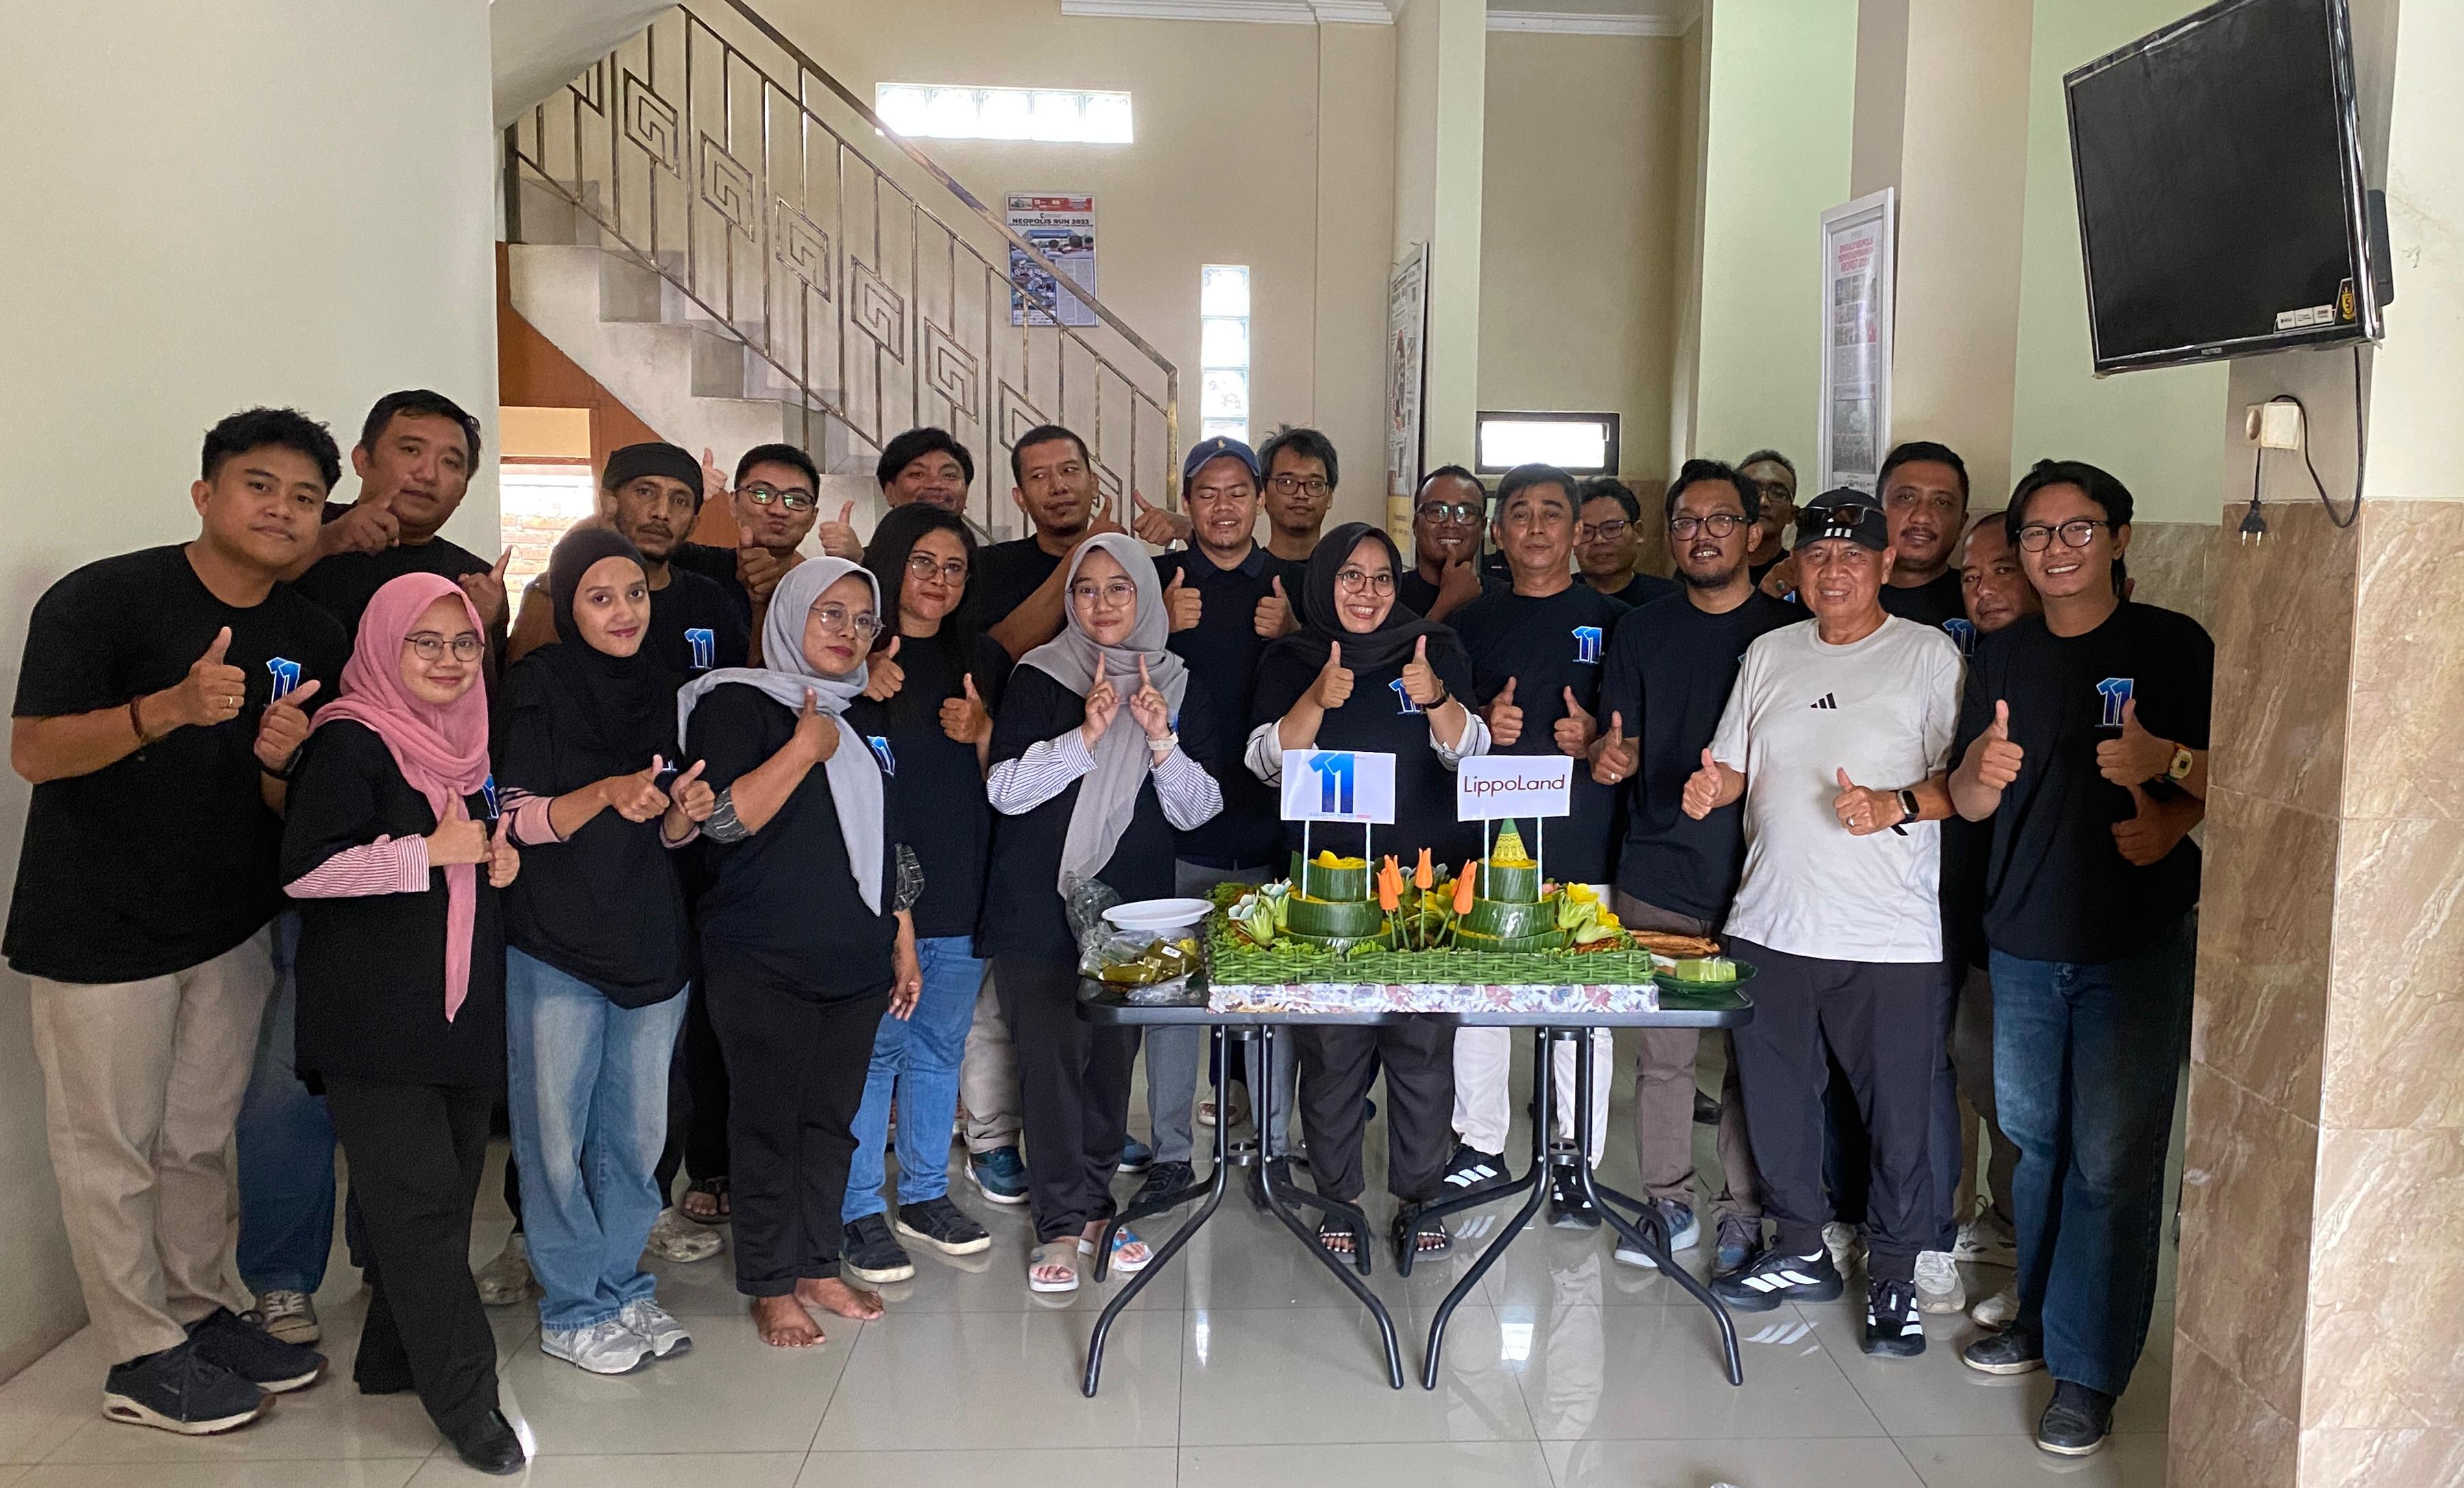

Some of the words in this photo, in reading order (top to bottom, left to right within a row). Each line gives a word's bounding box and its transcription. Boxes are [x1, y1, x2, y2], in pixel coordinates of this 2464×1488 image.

[684, 628, 714, 670] 11
[1571, 626, 1602, 663] 11
[1942, 618, 1977, 657] 11
[266, 657, 302, 705] 11
[2096, 677, 2134, 726] 11
[867, 735, 895, 775] 11
[1307, 753, 1355, 814] 11
[1464, 774, 1565, 798] LippoLand
